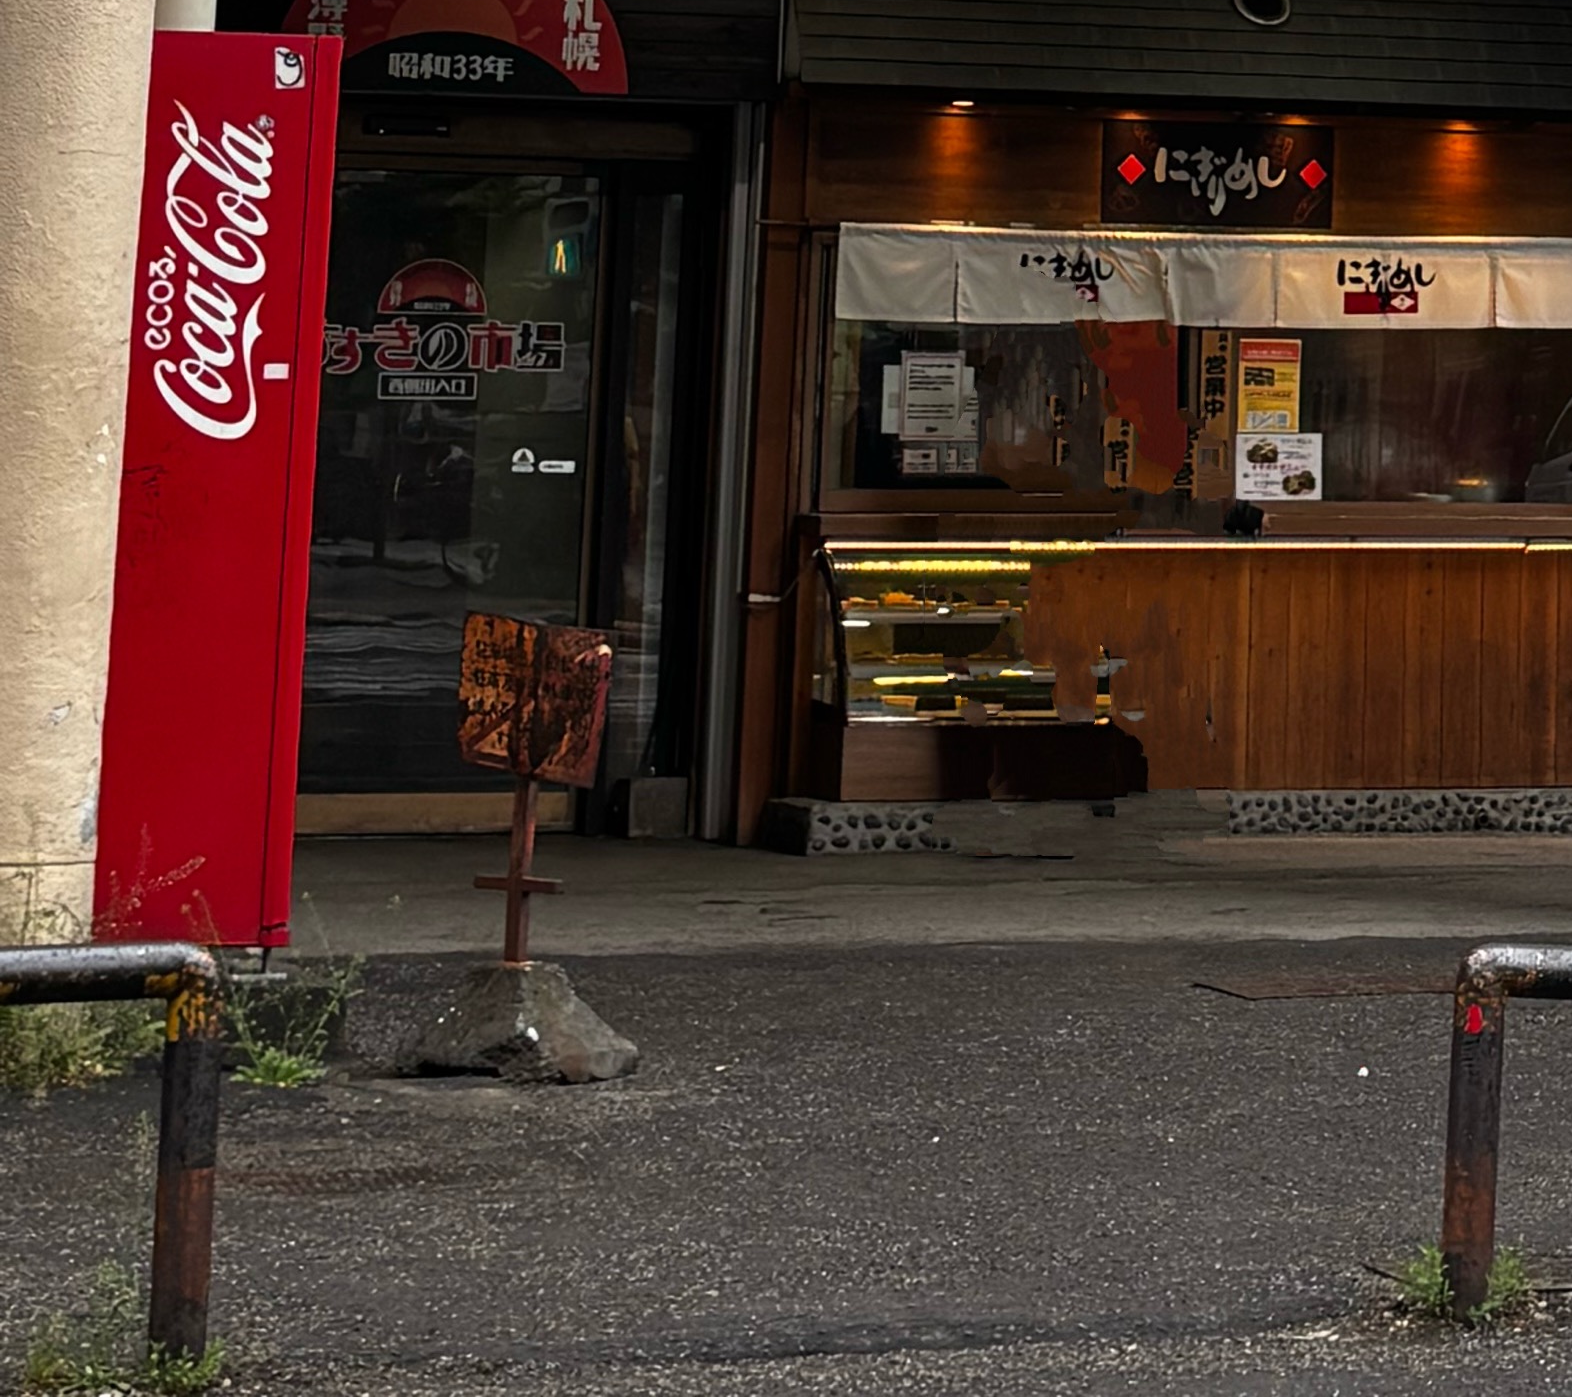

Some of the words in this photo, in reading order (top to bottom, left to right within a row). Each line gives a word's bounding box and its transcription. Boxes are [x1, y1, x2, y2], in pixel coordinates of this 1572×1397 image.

[388, 52, 515, 83] 昭和33年
[1153, 145, 1288, 217] にぎりめし
[153, 98, 275, 440] Coca-Cola
[322, 317, 566, 375] すきの市場
